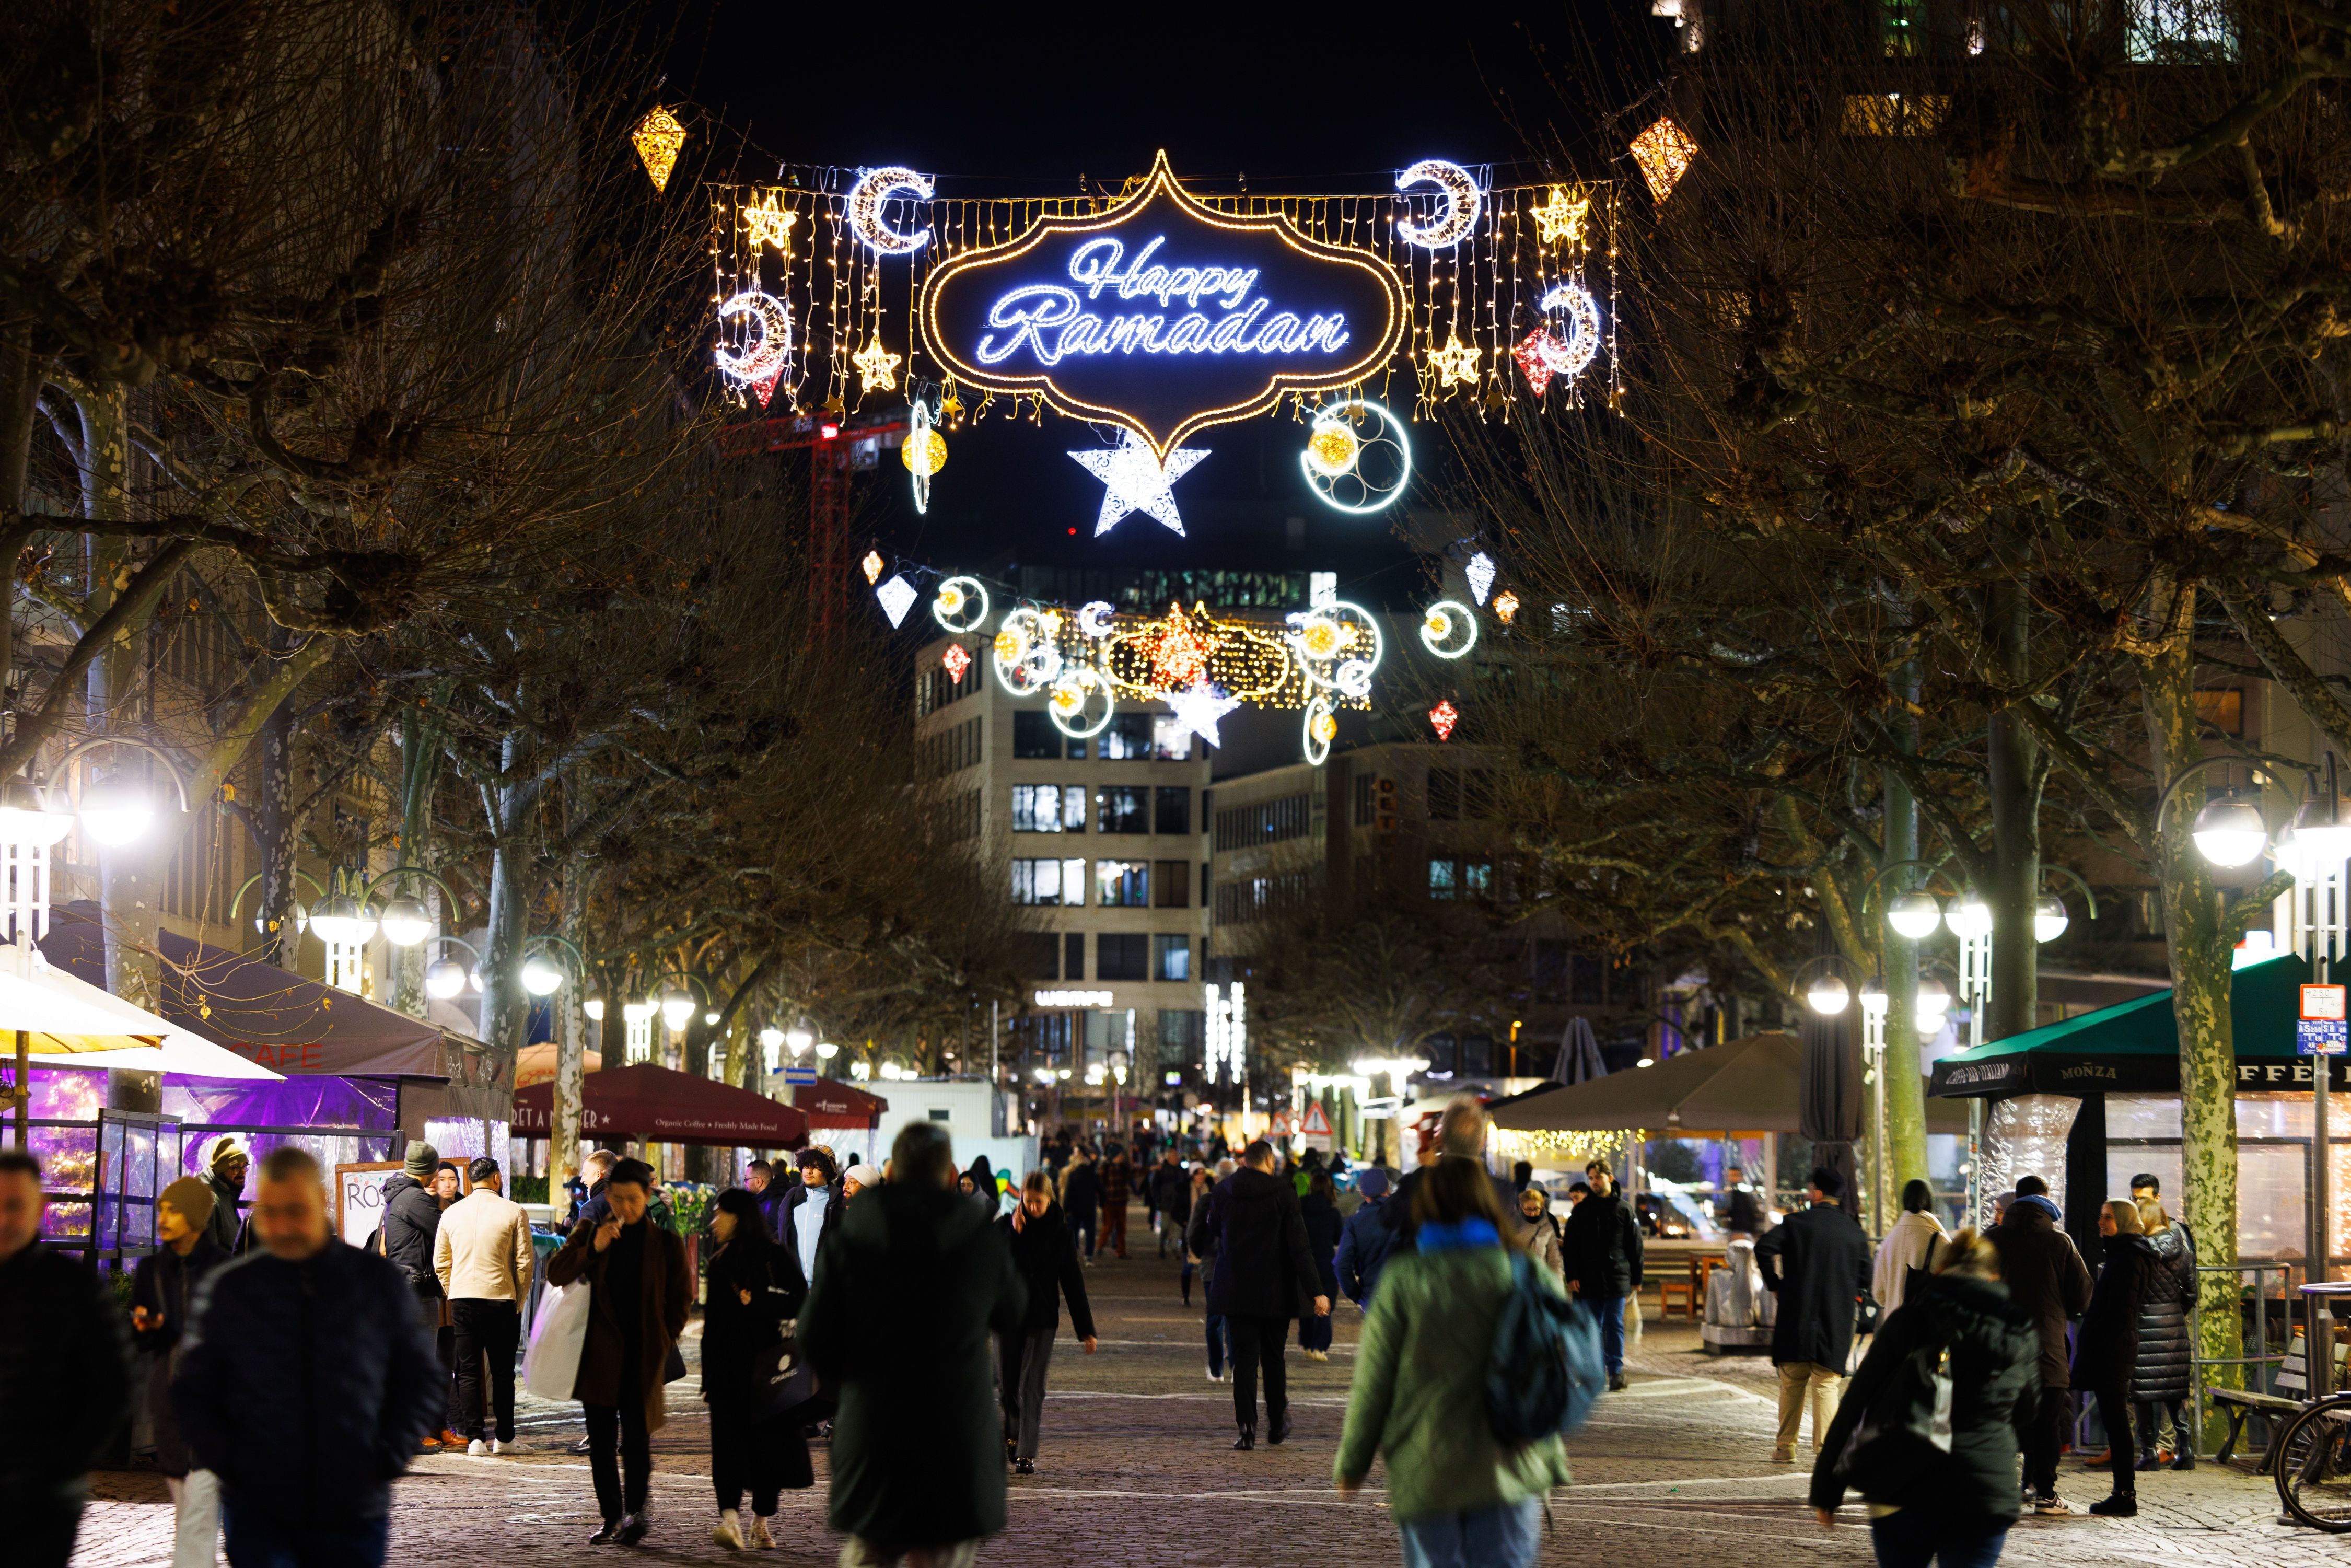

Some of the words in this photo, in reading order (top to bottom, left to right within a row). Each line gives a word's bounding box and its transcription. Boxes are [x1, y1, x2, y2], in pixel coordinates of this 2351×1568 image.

[1069, 235, 1260, 309] Happy
[976, 284, 1350, 366] Ramadan
[2237, 1059, 2313, 1082] FFÈ
[511, 1108, 533, 1128] RET
[537, 1109, 544, 1128] A
[655, 1119, 682, 1128] Organic
[684, 1120, 706, 1128] Coffee
[714, 1121, 737, 1131] Freshly
[740, 1122, 759, 1130] Made
[760, 1123, 777, 1132] Food
[347, 1182, 386, 1210] RO
